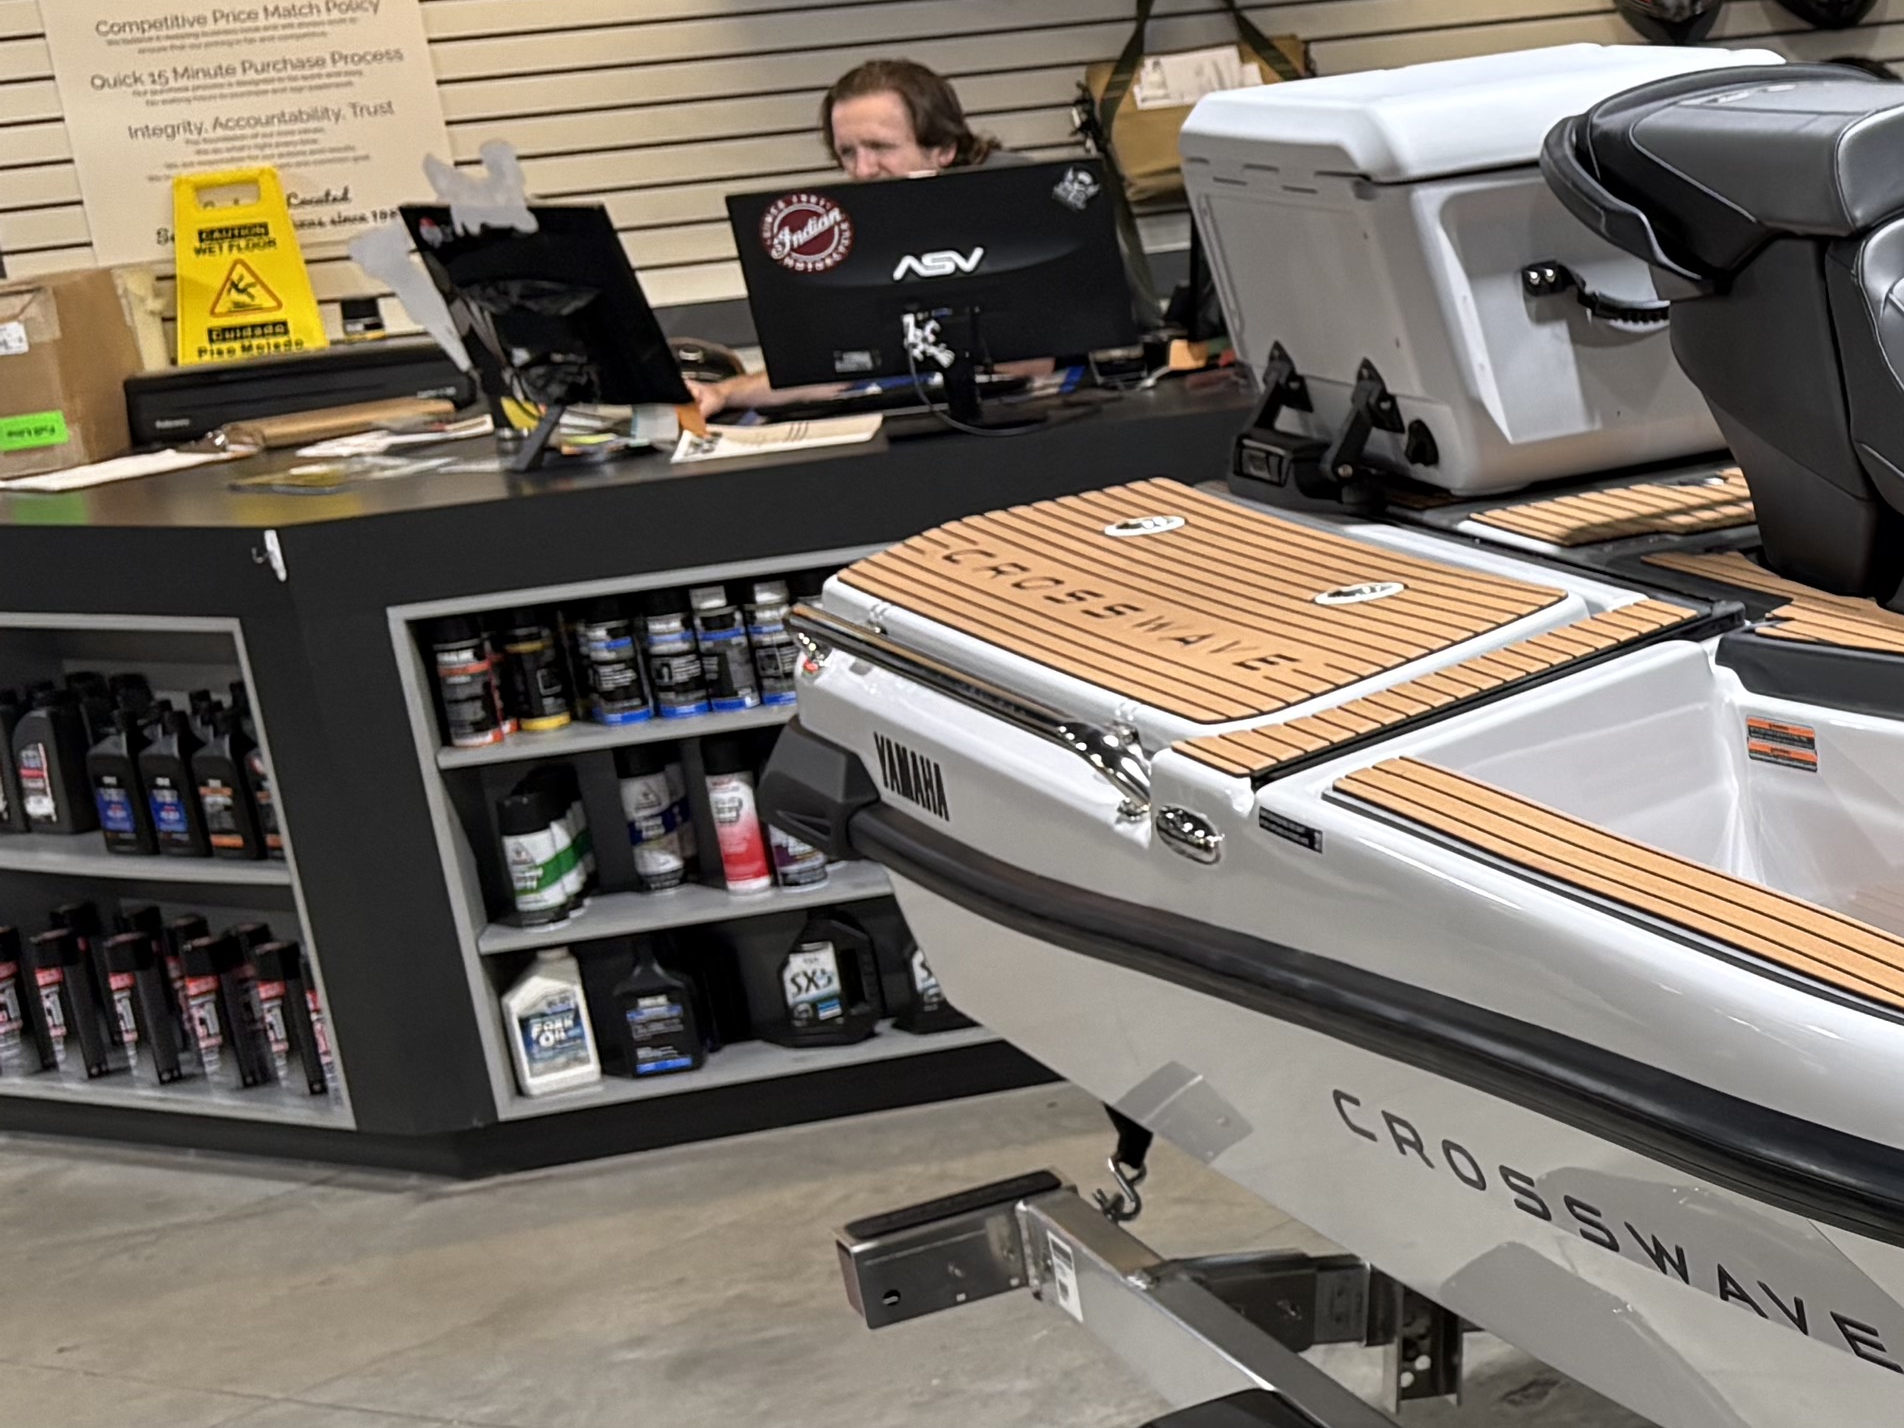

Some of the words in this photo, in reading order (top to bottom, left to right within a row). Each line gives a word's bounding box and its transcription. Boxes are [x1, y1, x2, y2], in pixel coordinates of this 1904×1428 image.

[95, 13, 209, 39] Competitive
[212, 7, 259, 26] Price
[263, 2, 322, 21] Match
[90, 70, 145, 91] Quick
[172, 63, 237, 83] Minute
[241, 56, 327, 77] Purchase
[329, 47, 404, 68] Process
[348, 99, 395, 119] Trust
[201, 223, 268, 241] CAUTION
[771, 205, 844, 260] Indian
[194, 242, 226, 257] WET
[228, 238, 277, 254] FLOOR
[198, 344, 237, 359] Piso
[941, 546, 1303, 675] CROSSWAVE
[872, 731, 951, 822] YAMAHA
[531, 1016, 575, 1037] FORK
